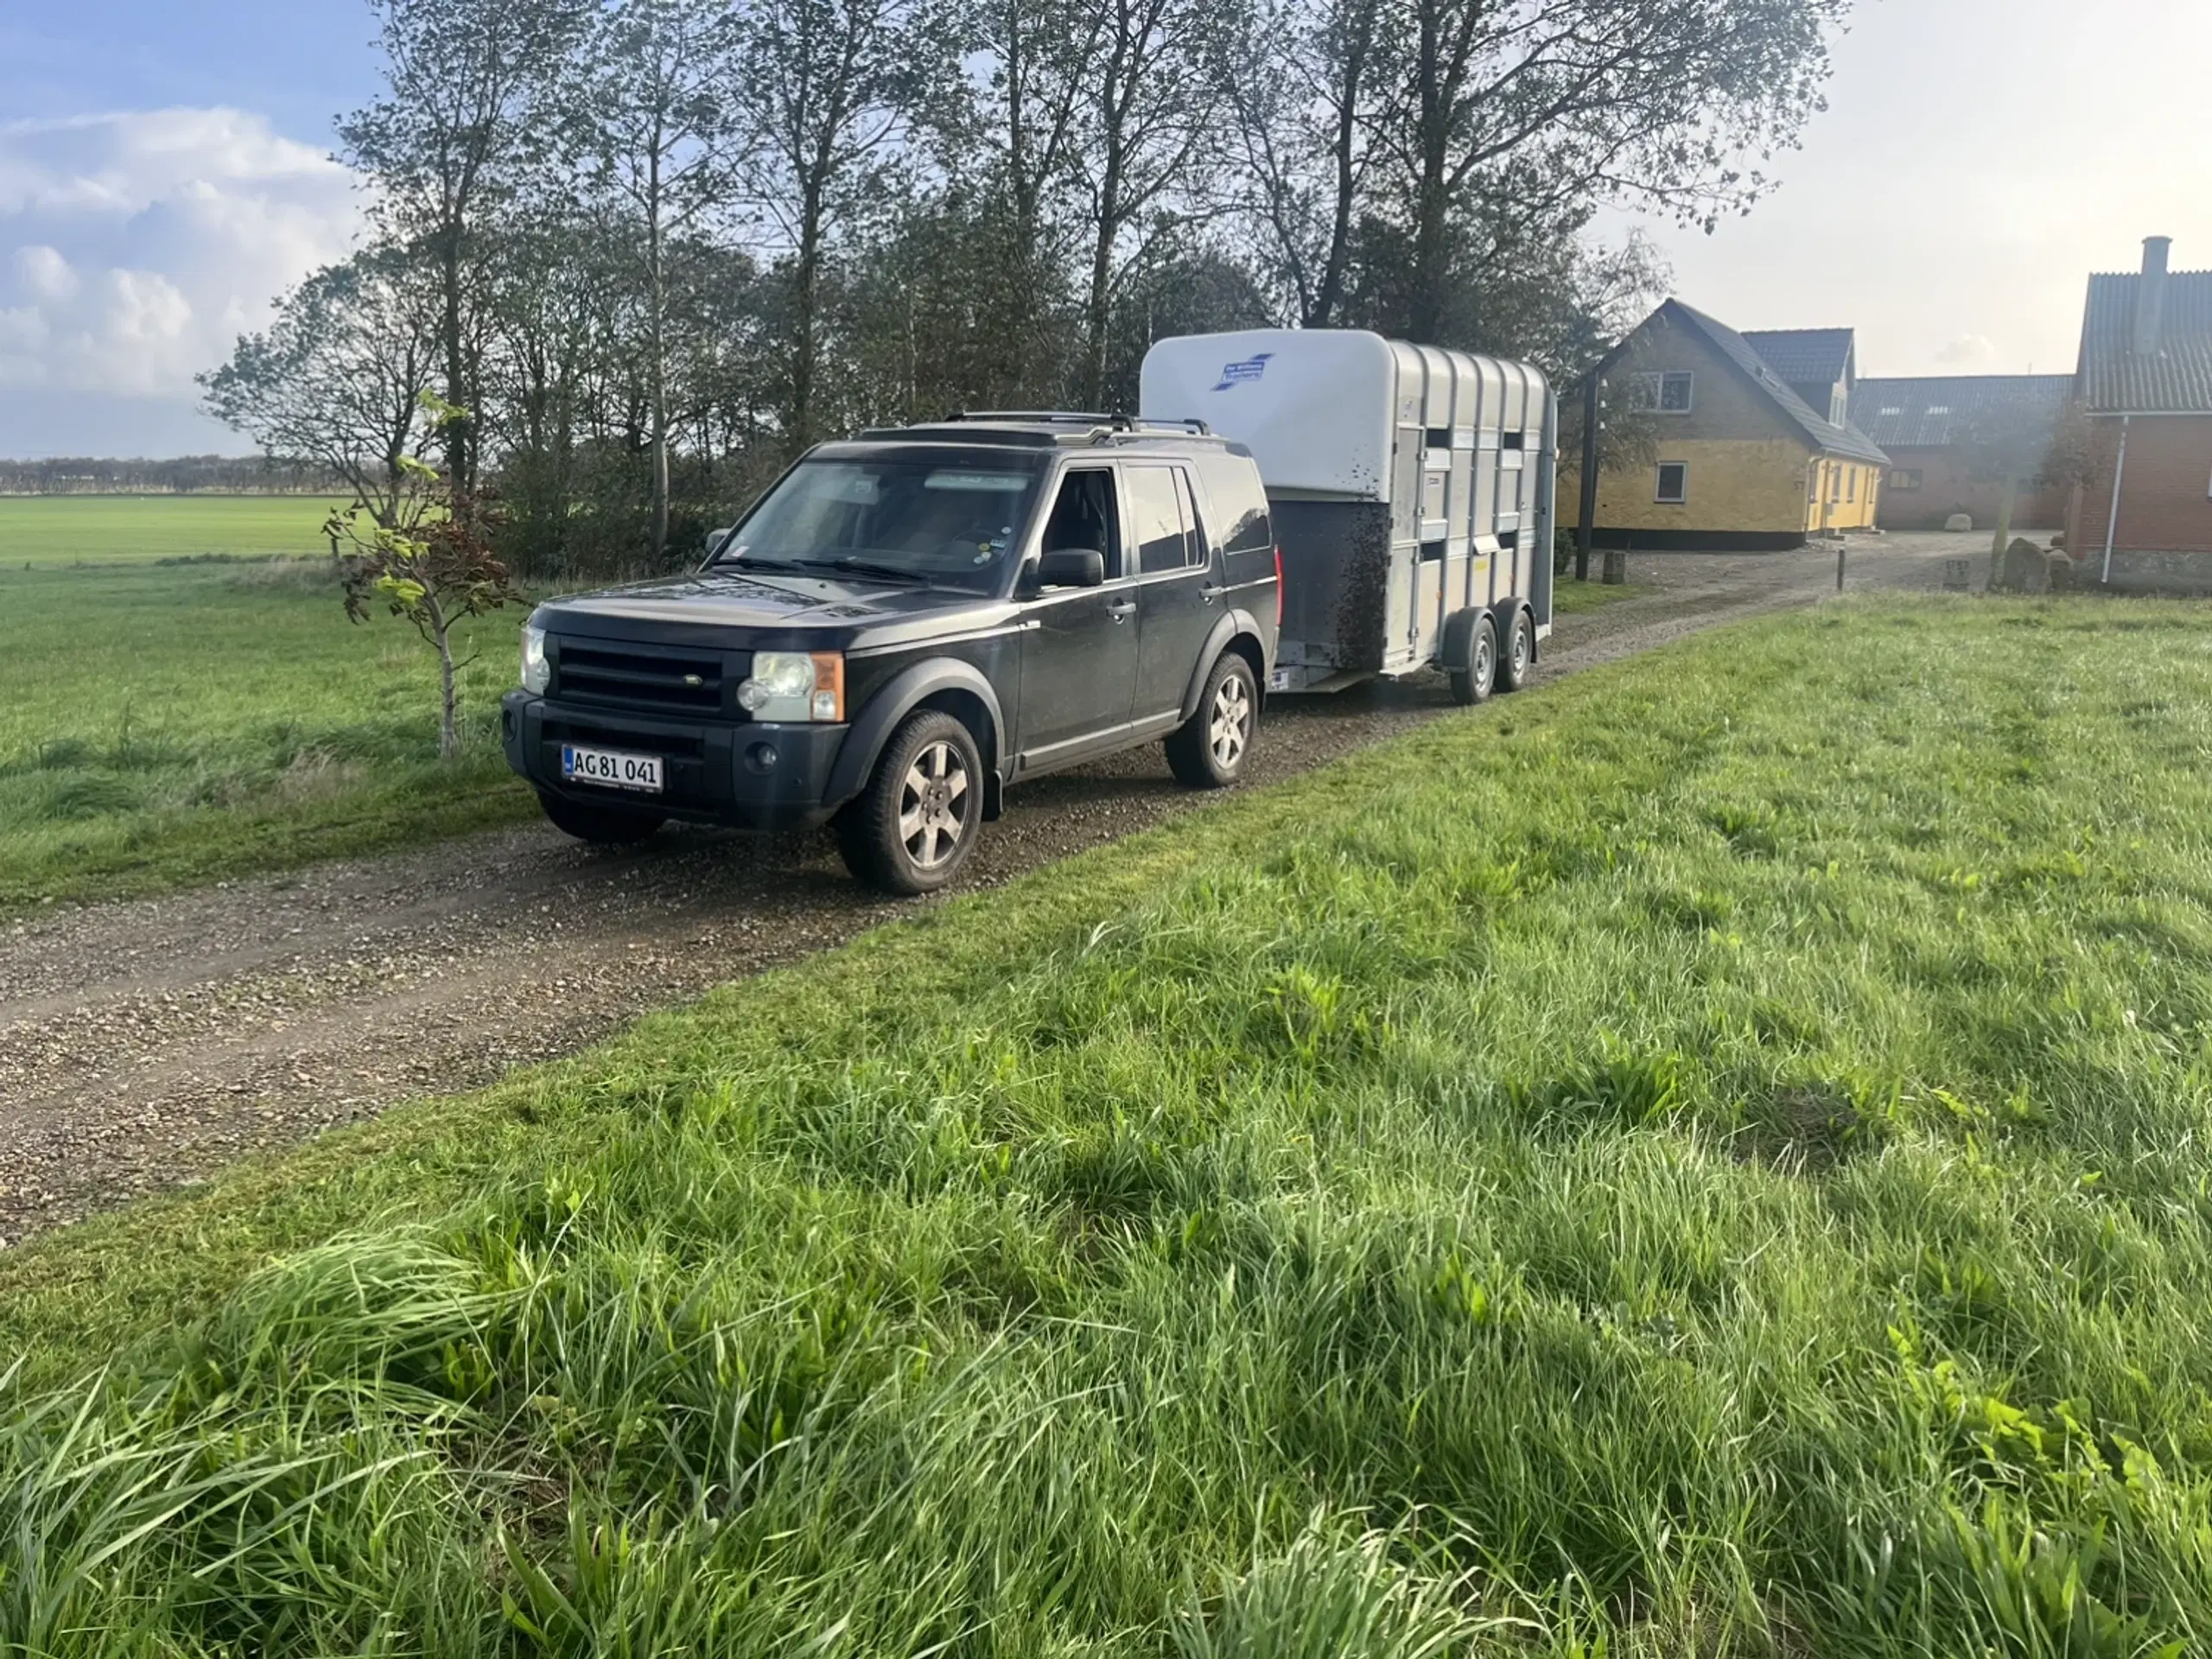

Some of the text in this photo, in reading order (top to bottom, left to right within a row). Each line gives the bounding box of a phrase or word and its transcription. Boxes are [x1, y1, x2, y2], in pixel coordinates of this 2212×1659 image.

[575, 752, 657, 784] AG 81 041
